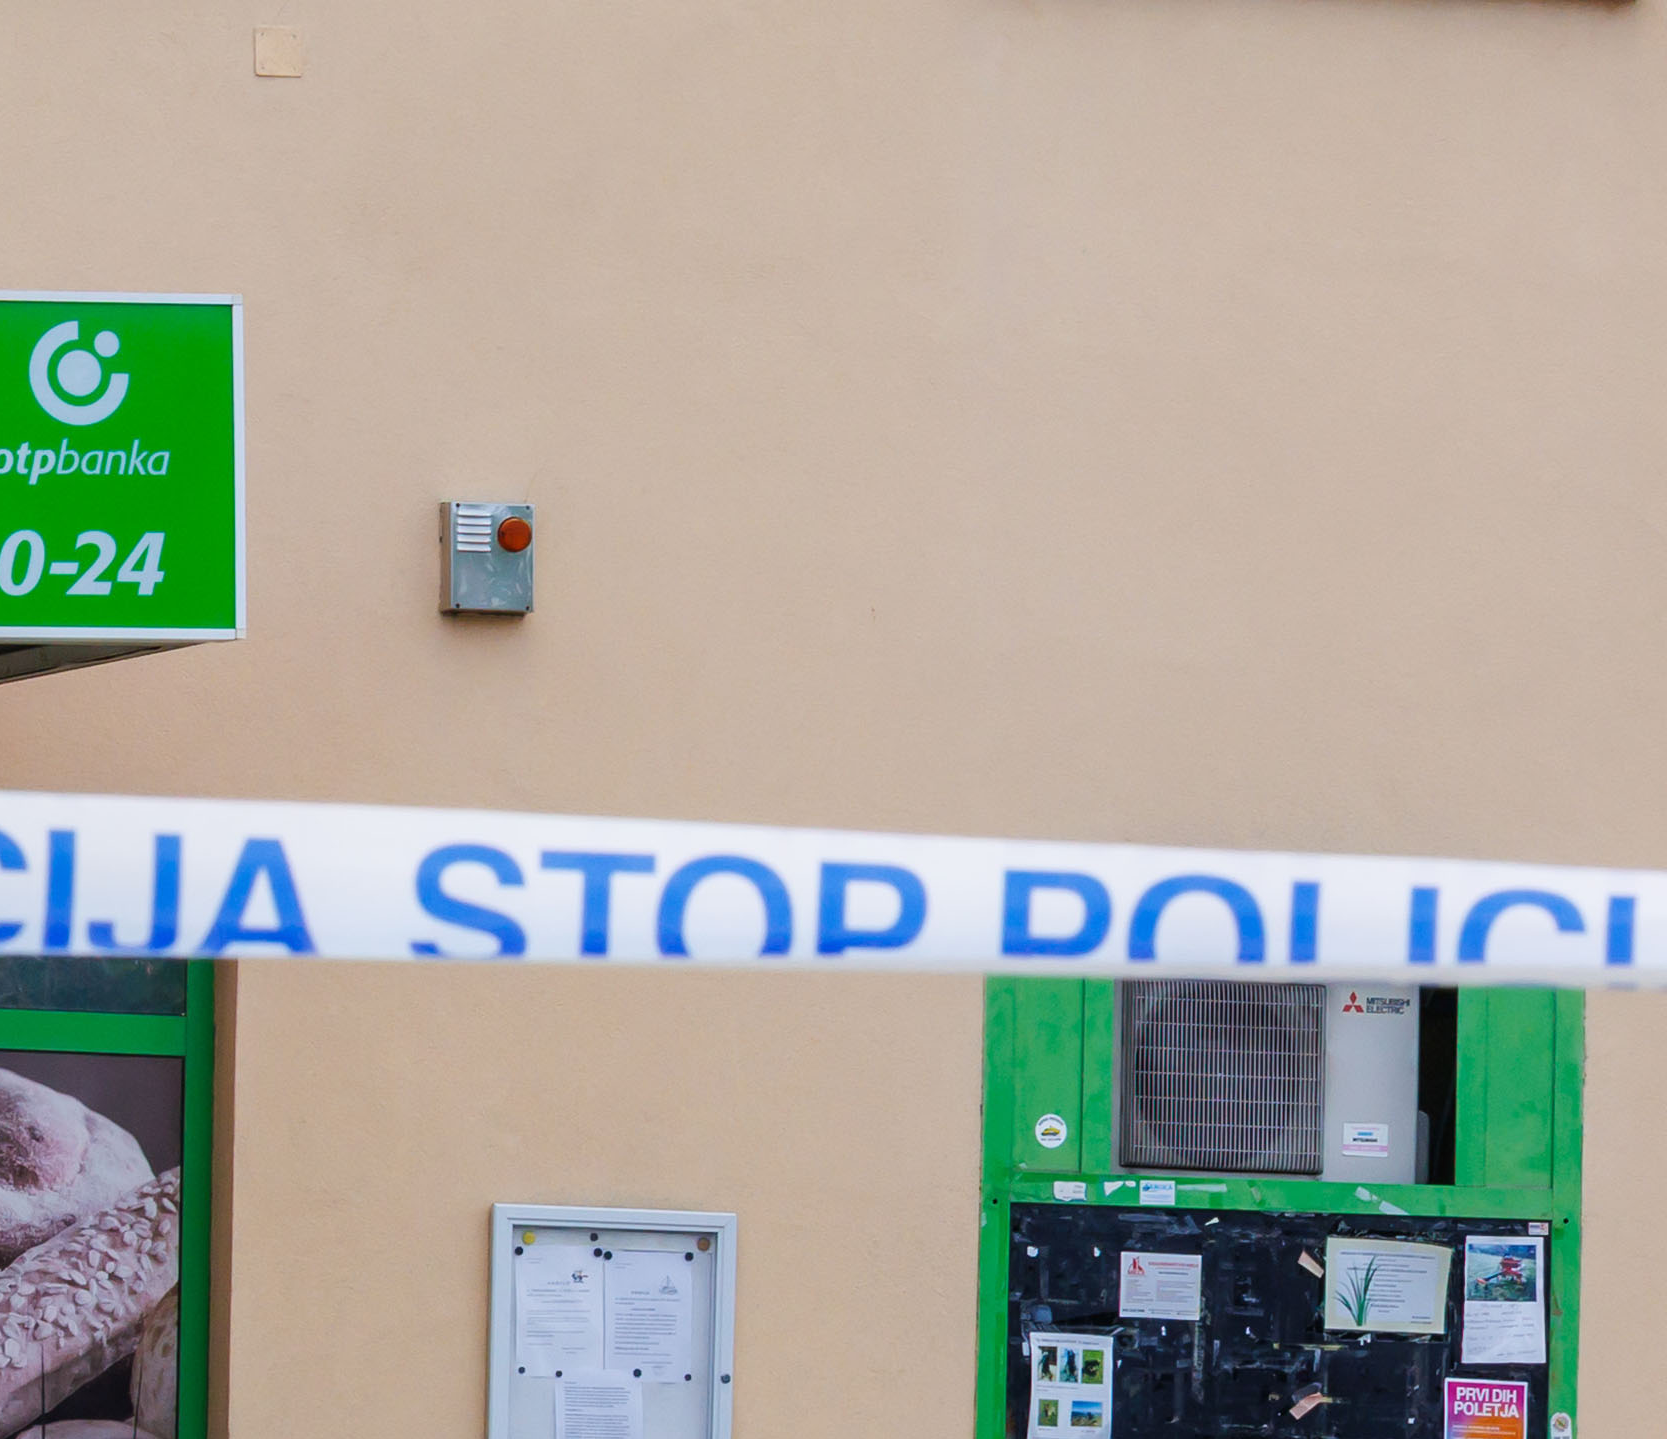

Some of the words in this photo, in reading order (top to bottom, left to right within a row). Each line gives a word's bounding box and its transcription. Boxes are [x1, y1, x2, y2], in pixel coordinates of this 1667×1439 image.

[413, 843, 928, 959] STOP
[1366, 997, 1411, 1007] MITSUBISHI
[1366, 1005, 1405, 1015] ELECTRIC
[1455, 1386, 1490, 1402] PRVI
[1492, 1389, 1517, 1404] DIH
[1453, 1401, 1520, 1419] POLETJA
